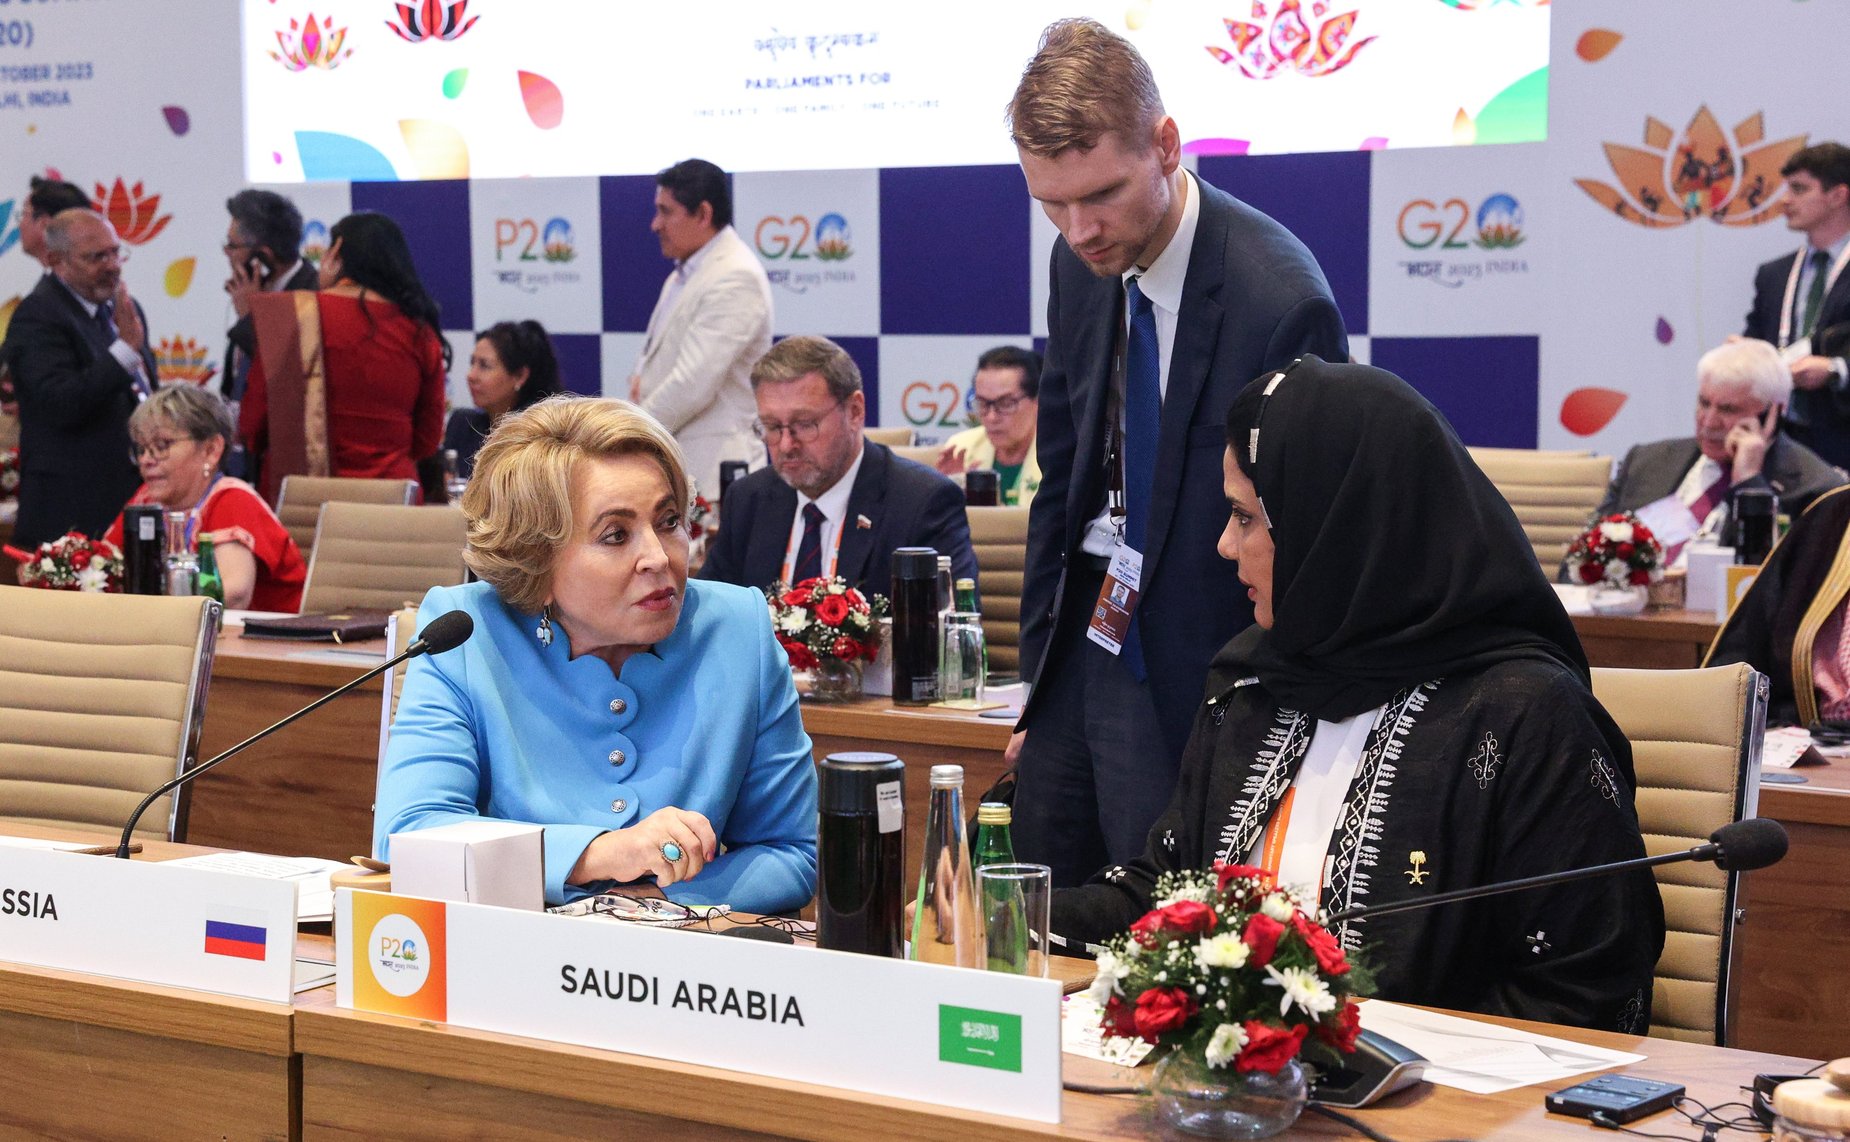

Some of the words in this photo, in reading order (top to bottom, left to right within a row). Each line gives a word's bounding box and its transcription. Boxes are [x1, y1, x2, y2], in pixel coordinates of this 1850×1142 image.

[901, 380, 978, 427] G2
[1, 888, 58, 921] SSIA
[381, 936, 418, 961] P20
[561, 964, 658, 1006] SAUDI
[672, 980, 805, 1027] ARABIA
